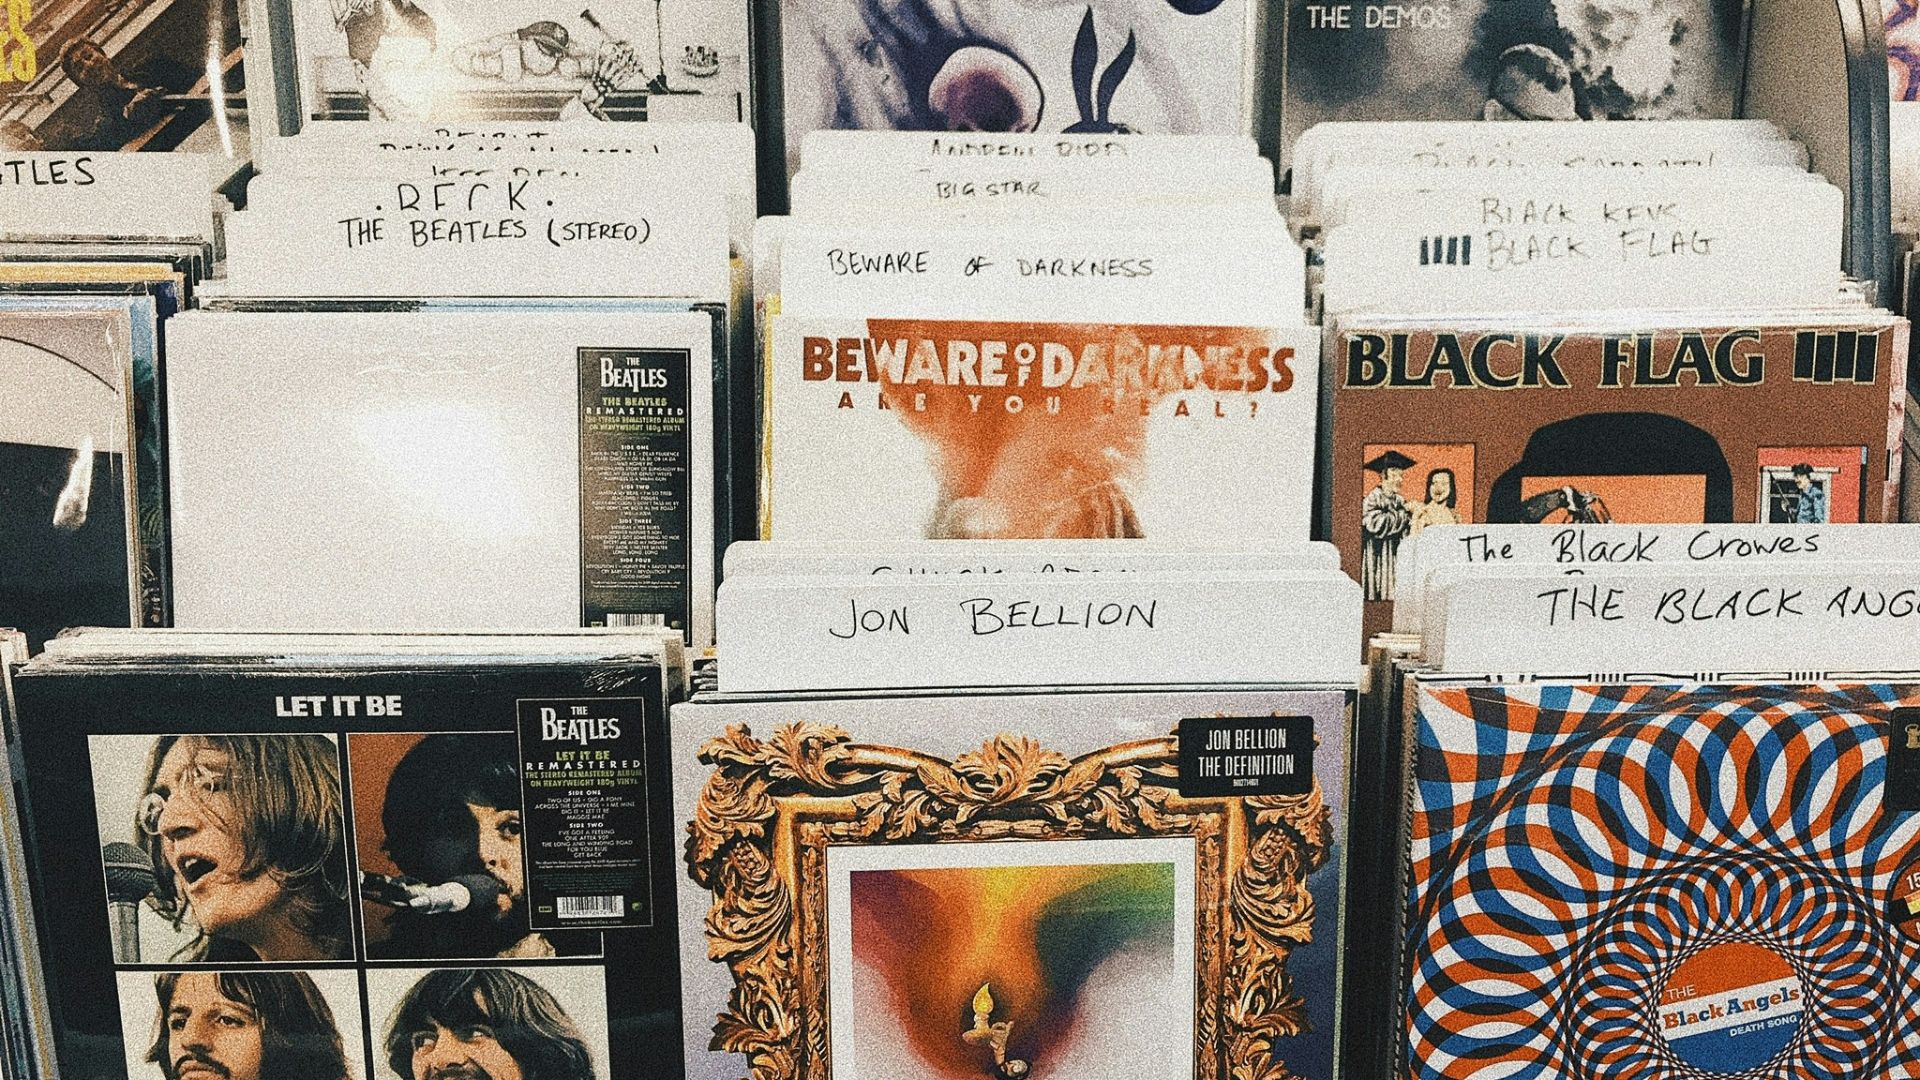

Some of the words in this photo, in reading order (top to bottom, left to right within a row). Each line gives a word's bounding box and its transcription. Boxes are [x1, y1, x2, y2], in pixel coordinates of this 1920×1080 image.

[1306, 5, 1352, 29] THE
[1365, 4, 1450, 29] DEMOS
[0, 157, 95, 186] TLES
[936, 182, 976, 199] BIG
[986, 180, 1047, 198] STAR
[338, 217, 385, 249] THE
[410, 218, 528, 248] BEATLES
[547, 217, 651, 248] (STEREO)
[1486, 229, 1591, 272] BLACK
[1619, 228, 1716, 263] FLAG
[827, 248, 930, 276] BEWARE
[963, 255, 994, 277] OF
[1016, 257, 1154, 279] DARKNESS
[626, 357, 640, 366] THE
[803, 337, 1009, 388] BEWARE
[1013, 342, 1037, 388] OF
[1041, 342, 1296, 393] DARKNESS
[1342, 330, 1572, 389] BLACK
[1597, 329, 1766, 388] FLAG
[600, 357, 668, 393] BEATLES
[586, 407, 684, 415] REMASTERED
[602, 397, 621, 406] THE
[625, 397, 667, 407] BEATLES
[837, 391, 927, 413] ARE
[967, 394, 1061, 416] YOU
[1102, 399, 1259, 419] REAL?
[1458, 533, 1514, 562] The
[1551, 529, 1660, 562] Black
[1687, 530, 1820, 560] Crowes
[829, 599, 910, 639] JON
[960, 598, 1157, 636] BELLION
[1537, 585, 1625, 626] THE
[1654, 588, 1804, 624] BLACK
[1826, 586, 1920, 619] ANG
[275, 696, 327, 717] LET
[332, 696, 361, 717] IT
[366, 695, 403, 717] BE
[570, 706, 588, 716] THE
[540, 707, 621, 745] BEATLES
[1205, 729, 1231, 751] JON
[1235, 728, 1287, 750] BELLION
[526, 760, 641, 770] REMASTERED
[556, 751, 575, 761] LET
[580, 751, 591, 760] IT
[595, 750, 610, 760] BE
[1198, 756, 1221, 778] THE
[1225, 754, 1294, 777] DEFINITION
[1666, 984, 1698, 1001] THE
[1663, 1003, 1725, 1030] Black
[1726, 987, 1801, 1016] Angels
[1729, 1020, 1766, 1038] DEATH
[1767, 1014, 1798, 1029] SONG
